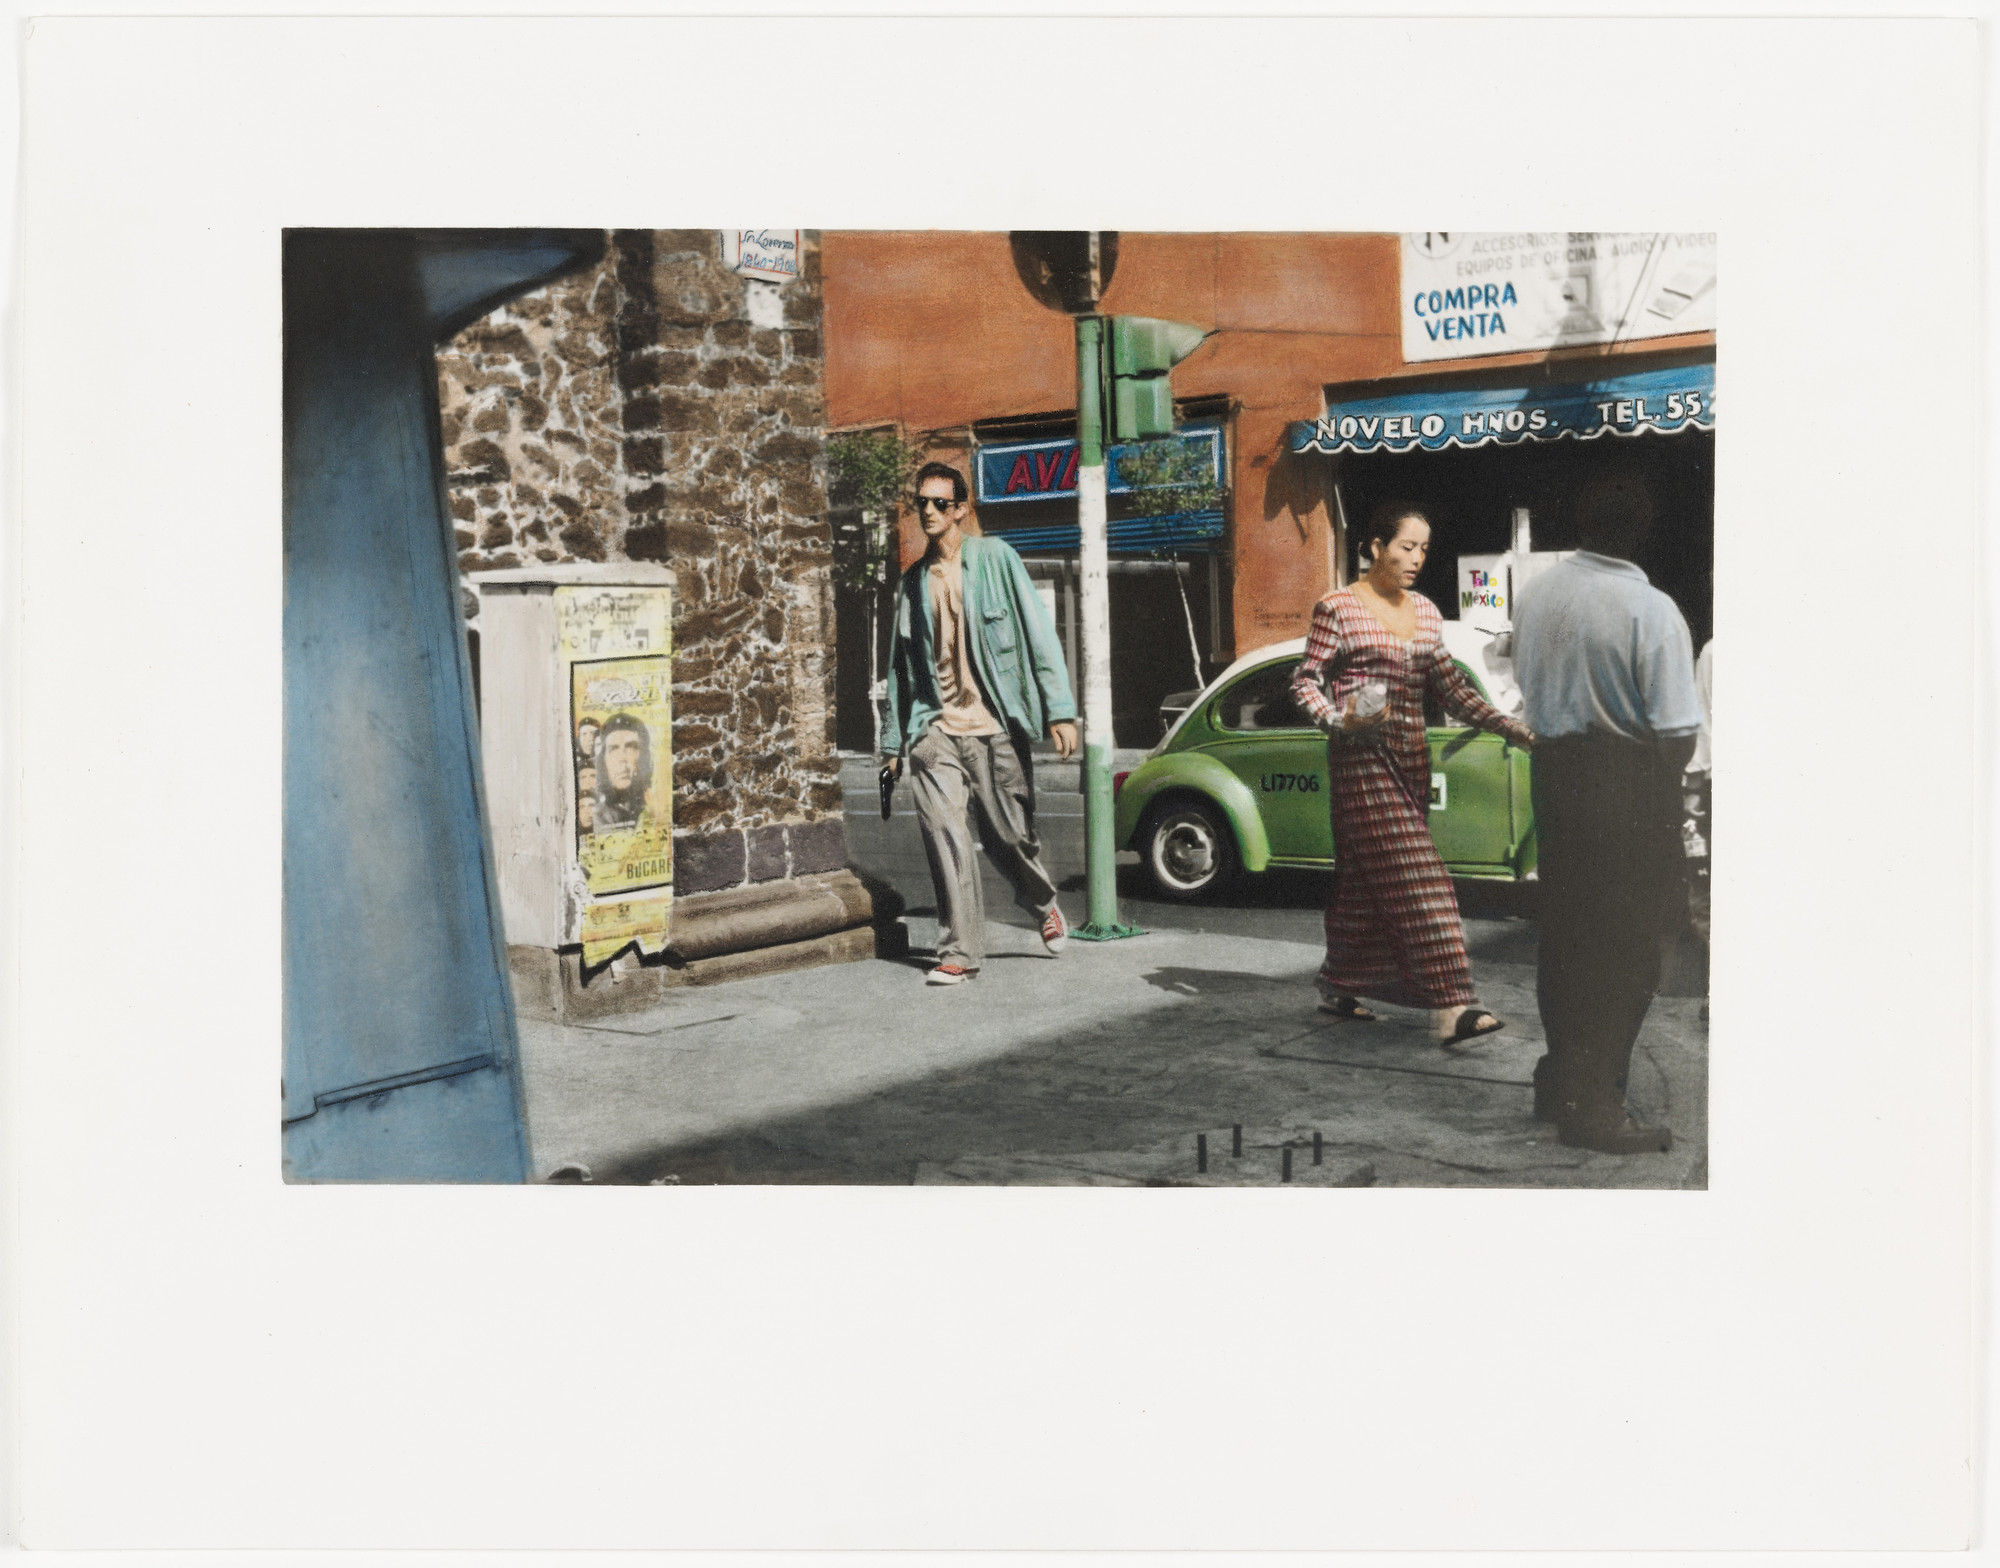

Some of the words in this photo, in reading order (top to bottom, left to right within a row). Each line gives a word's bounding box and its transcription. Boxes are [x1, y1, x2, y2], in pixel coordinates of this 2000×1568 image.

[1456, 255, 1513, 276] EQUIPOS
[1520, 252, 1538, 269] DE
[1414, 281, 1517, 317] COMPRA
[1424, 312, 1506, 341] VENTA
[1316, 413, 1446, 441] NOVELO
[1462, 409, 1559, 436] HNOS.
[1260, 773, 1320, 793] L17706
